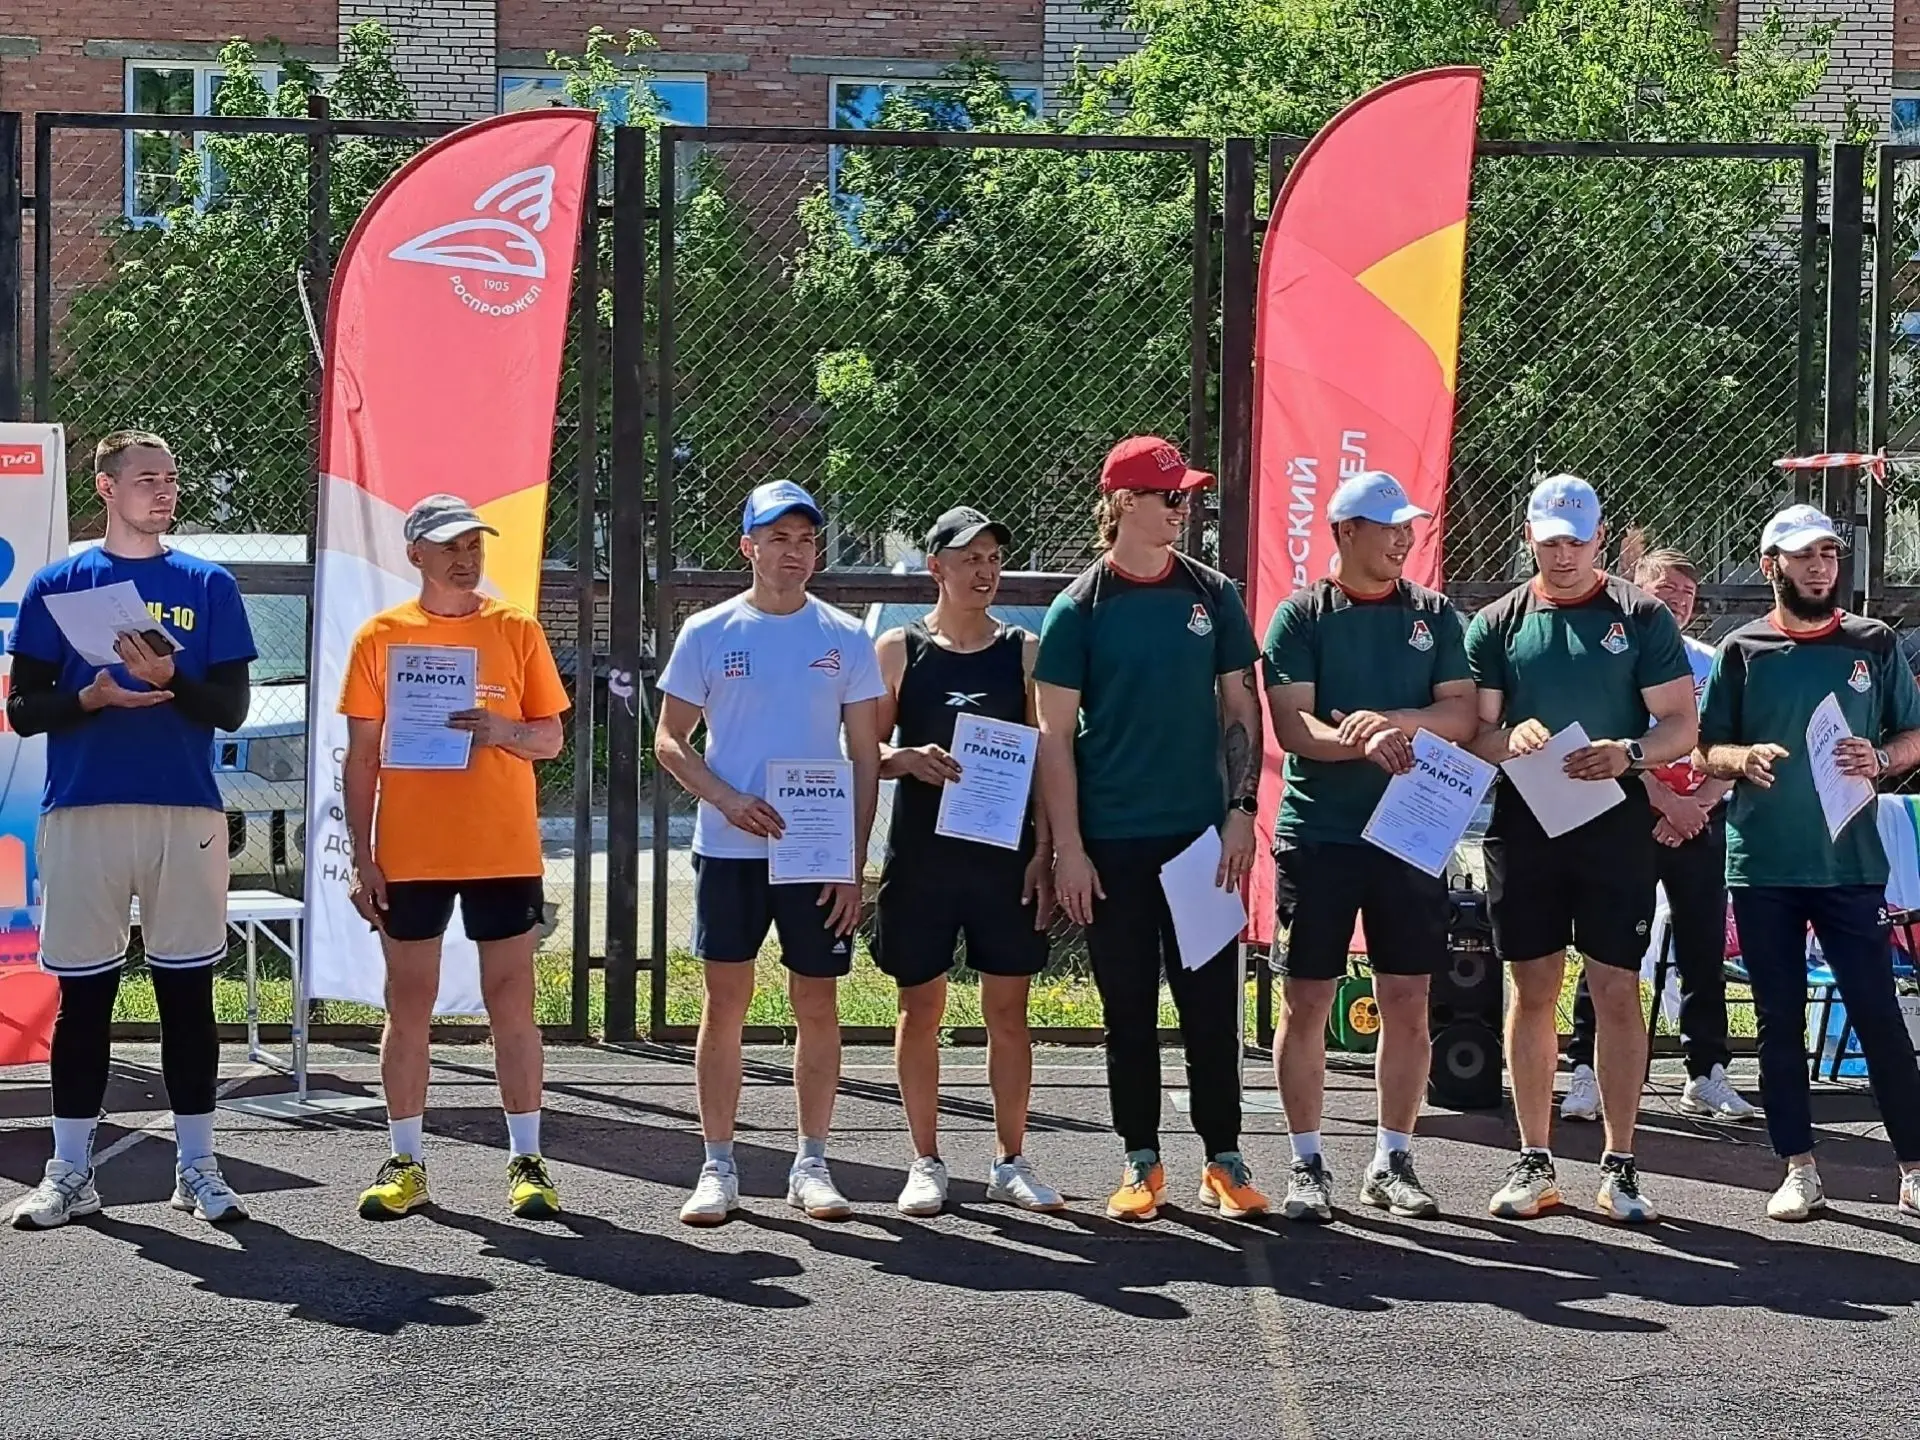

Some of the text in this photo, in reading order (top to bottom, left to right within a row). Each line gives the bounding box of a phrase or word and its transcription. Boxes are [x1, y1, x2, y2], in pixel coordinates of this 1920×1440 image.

[448, 275, 543, 317] РОСПРОФЖЕЛ
[483, 279, 510, 292] 1905
[1286, 457, 1318, 592] ЬСКИЙ
[397, 671, 467, 686] ГРАМОТА
[963, 742, 1027, 765] ГРАМОТА
[1415, 758, 1474, 797] ГРАМОТА
[778, 787, 846, 799] ГРАМОТА
